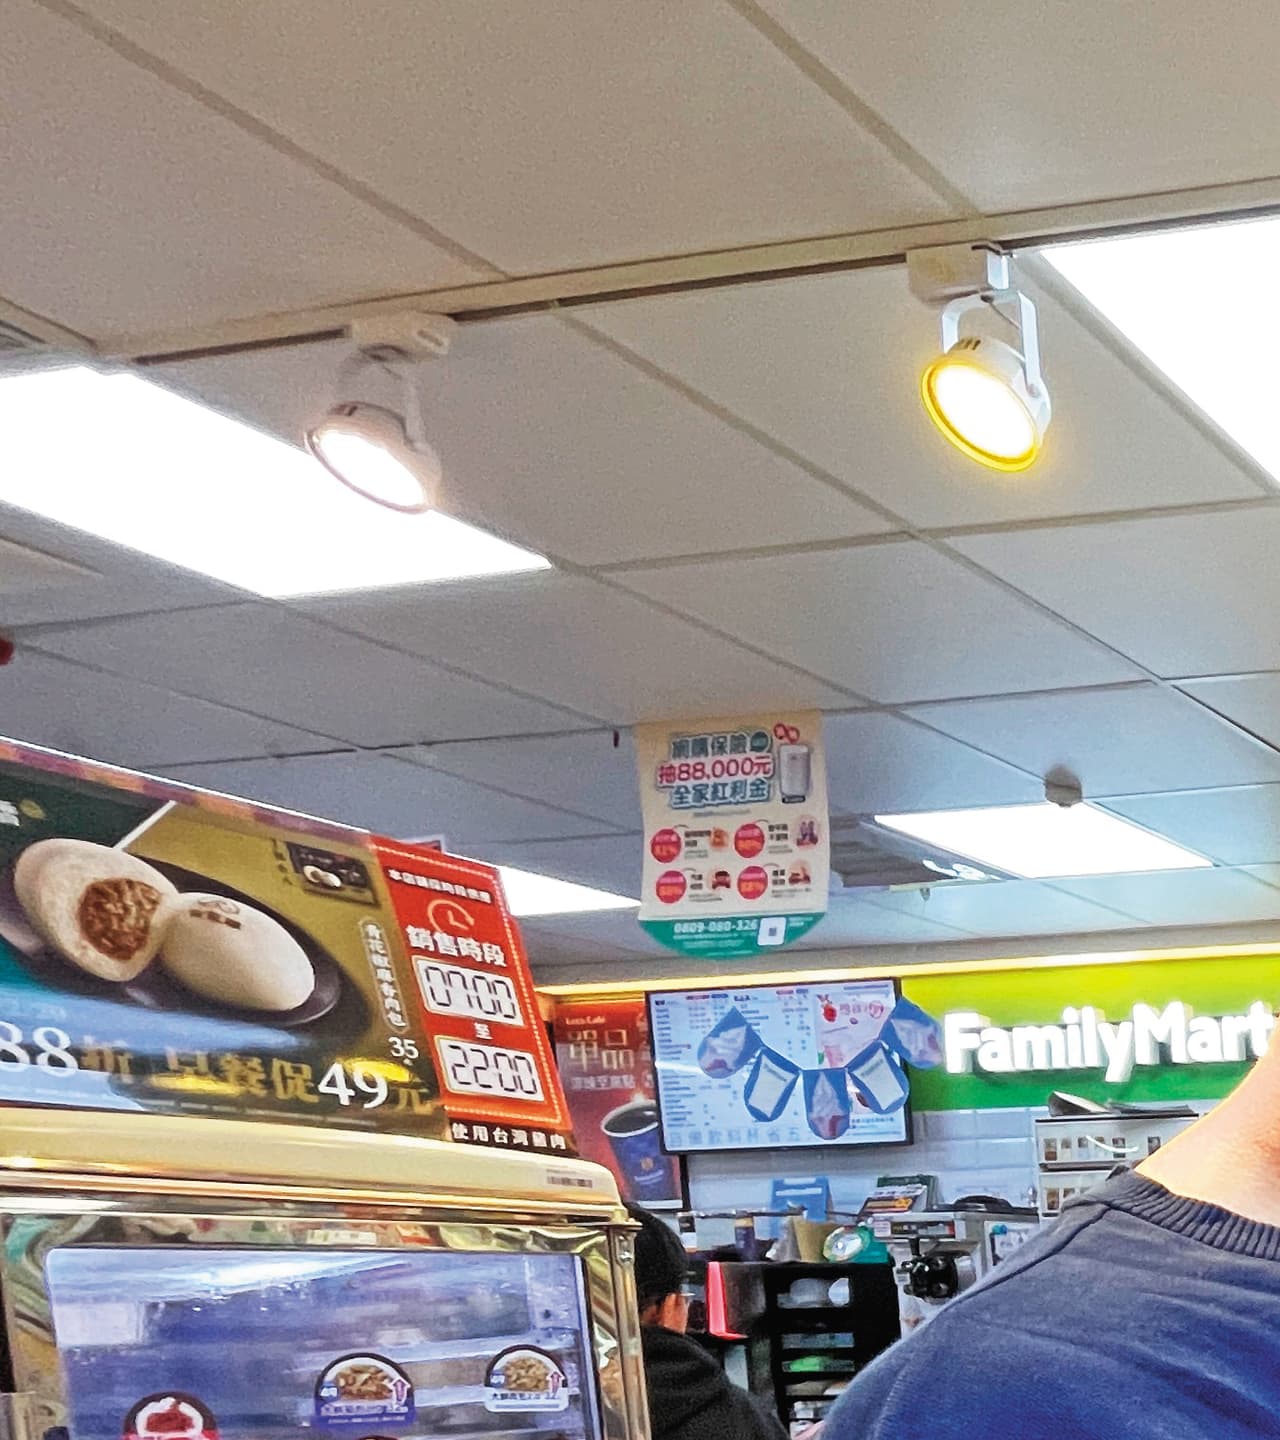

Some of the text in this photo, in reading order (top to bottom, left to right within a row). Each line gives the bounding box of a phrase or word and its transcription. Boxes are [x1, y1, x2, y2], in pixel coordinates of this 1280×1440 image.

[672, 779, 770, 806] 全家紅利金
[406, 925, 507, 967] 銷售時段
[474, 1022, 492, 1040] 至
[943, 1001, 1278, 1083] FamilyMart
[452, 1123, 566, 1150] 使用台灣豬肉
